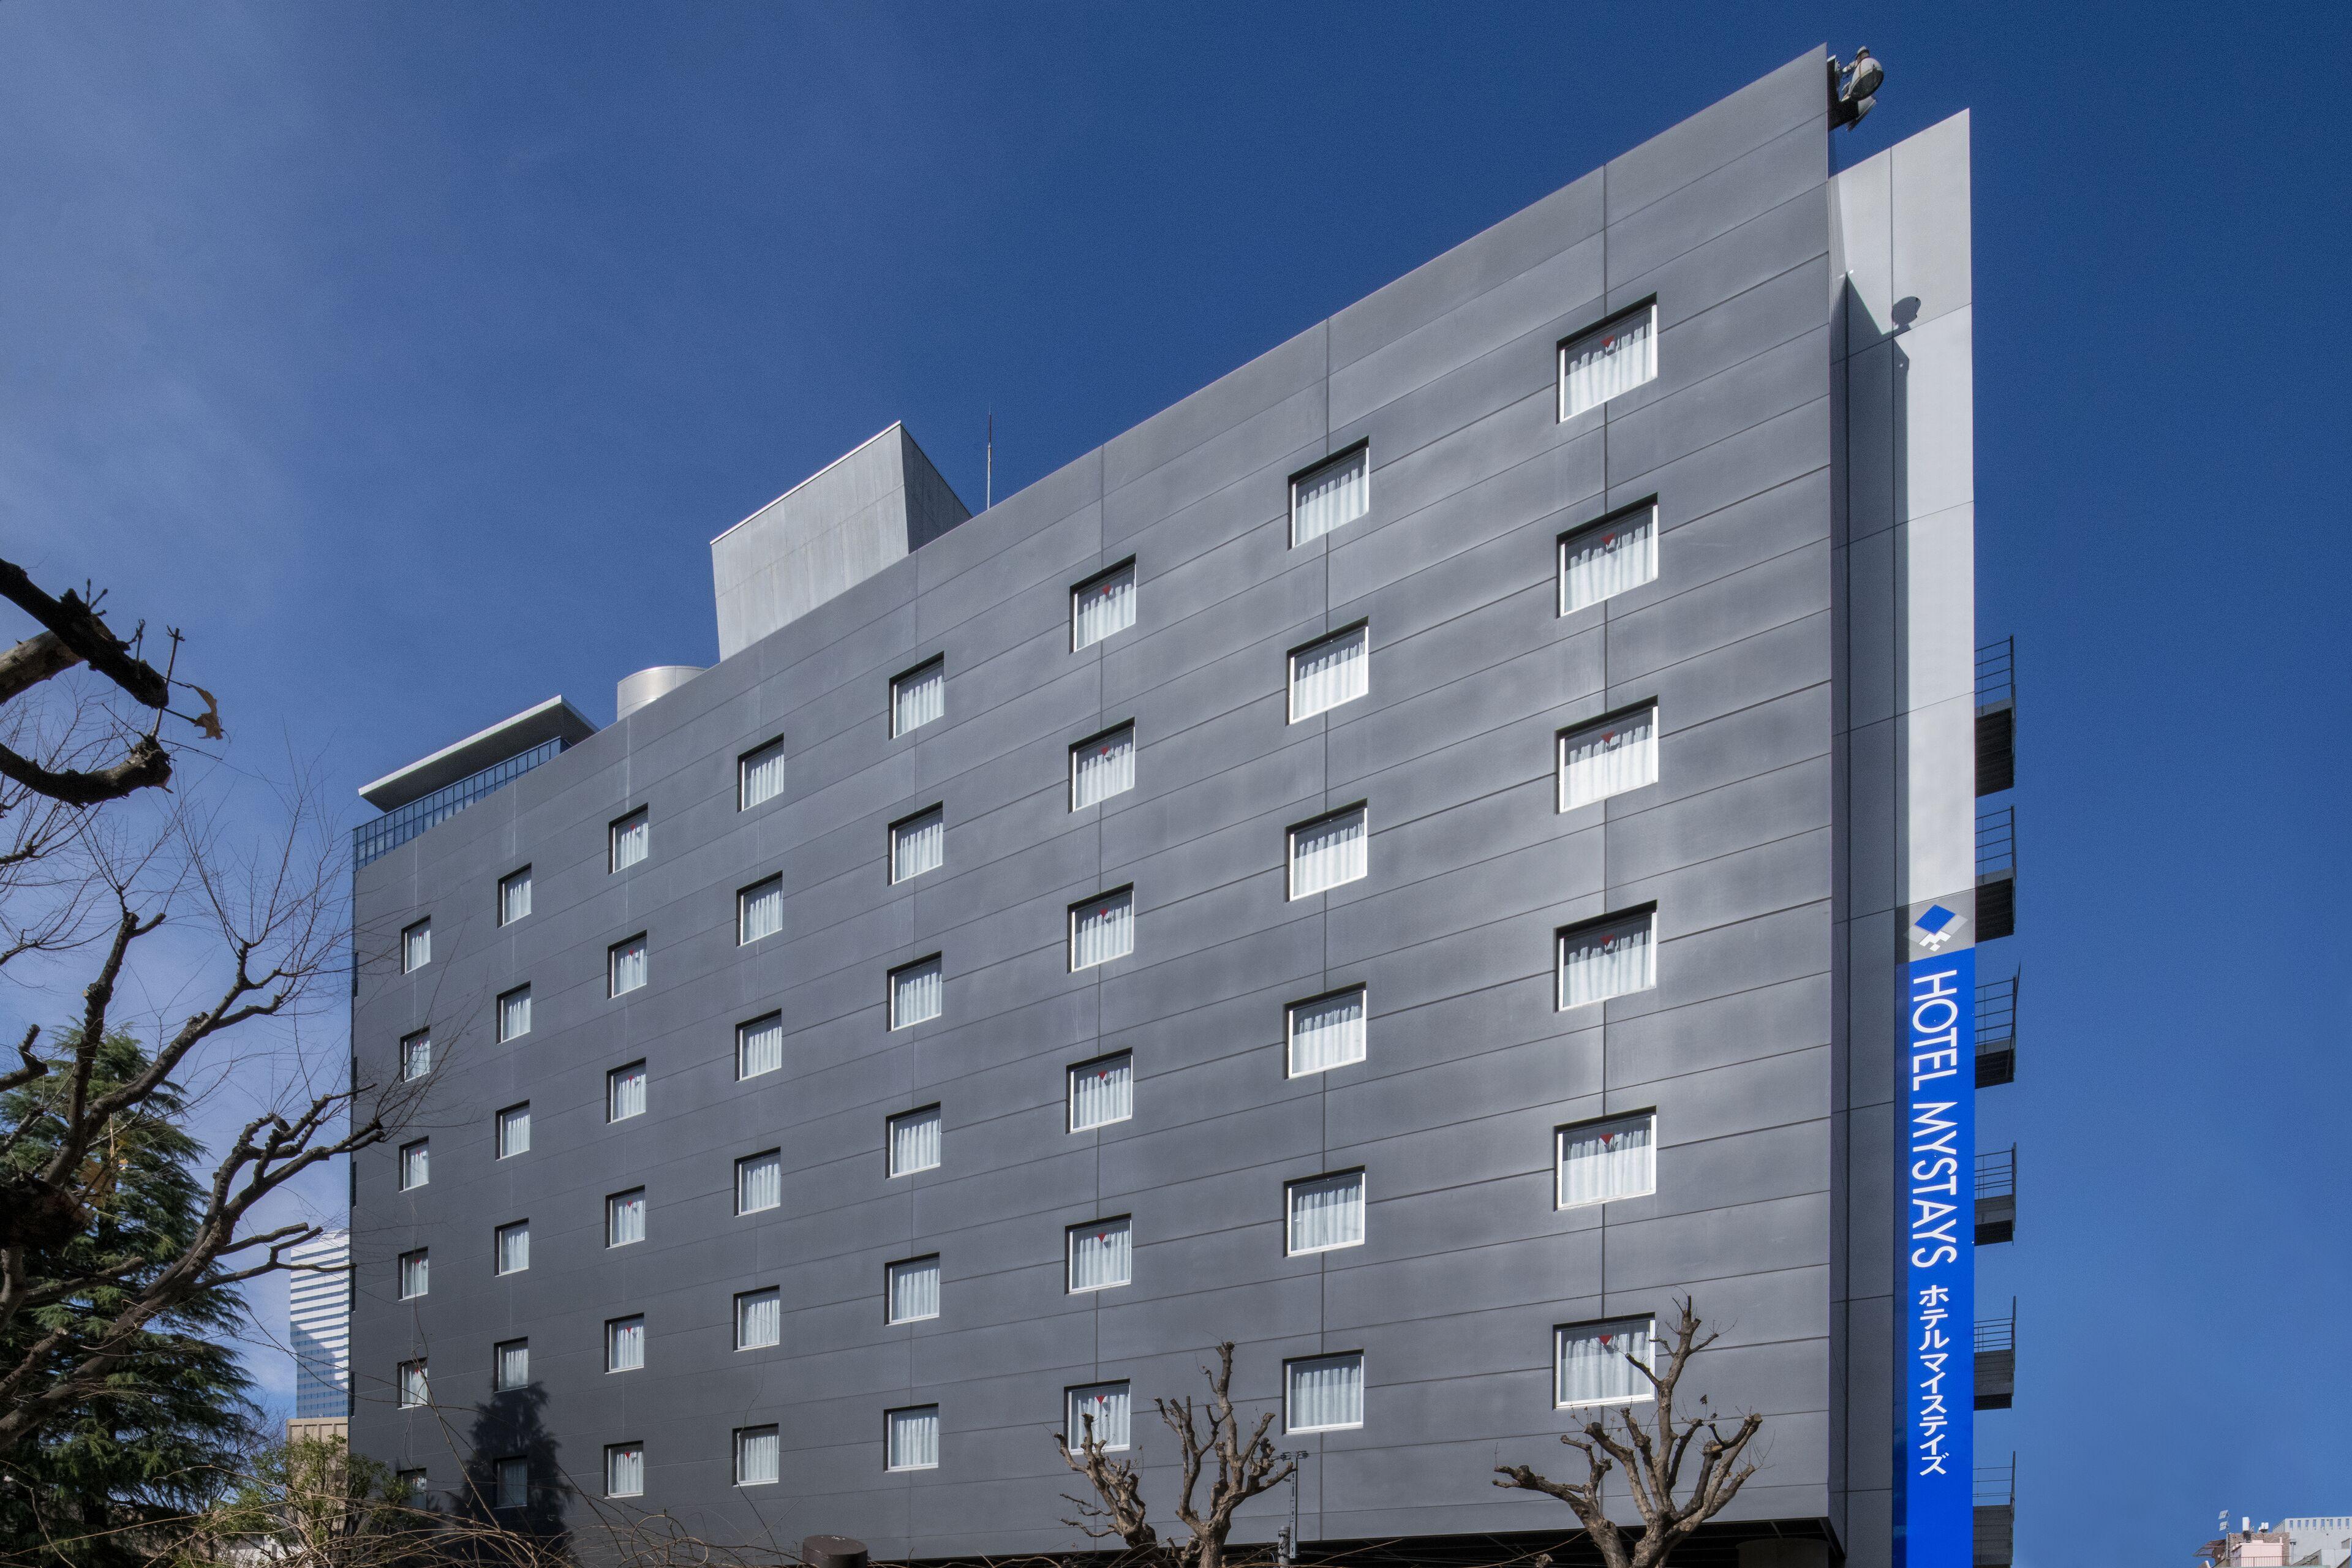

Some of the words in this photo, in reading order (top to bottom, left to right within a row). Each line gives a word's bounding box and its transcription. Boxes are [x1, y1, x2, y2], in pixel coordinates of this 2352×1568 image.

[1912, 970, 1958, 1091] HOTEL
[1912, 1101, 1958, 1268] MYSTAYS
[1918, 1284, 1950, 1476] ホテルマイステイズ
